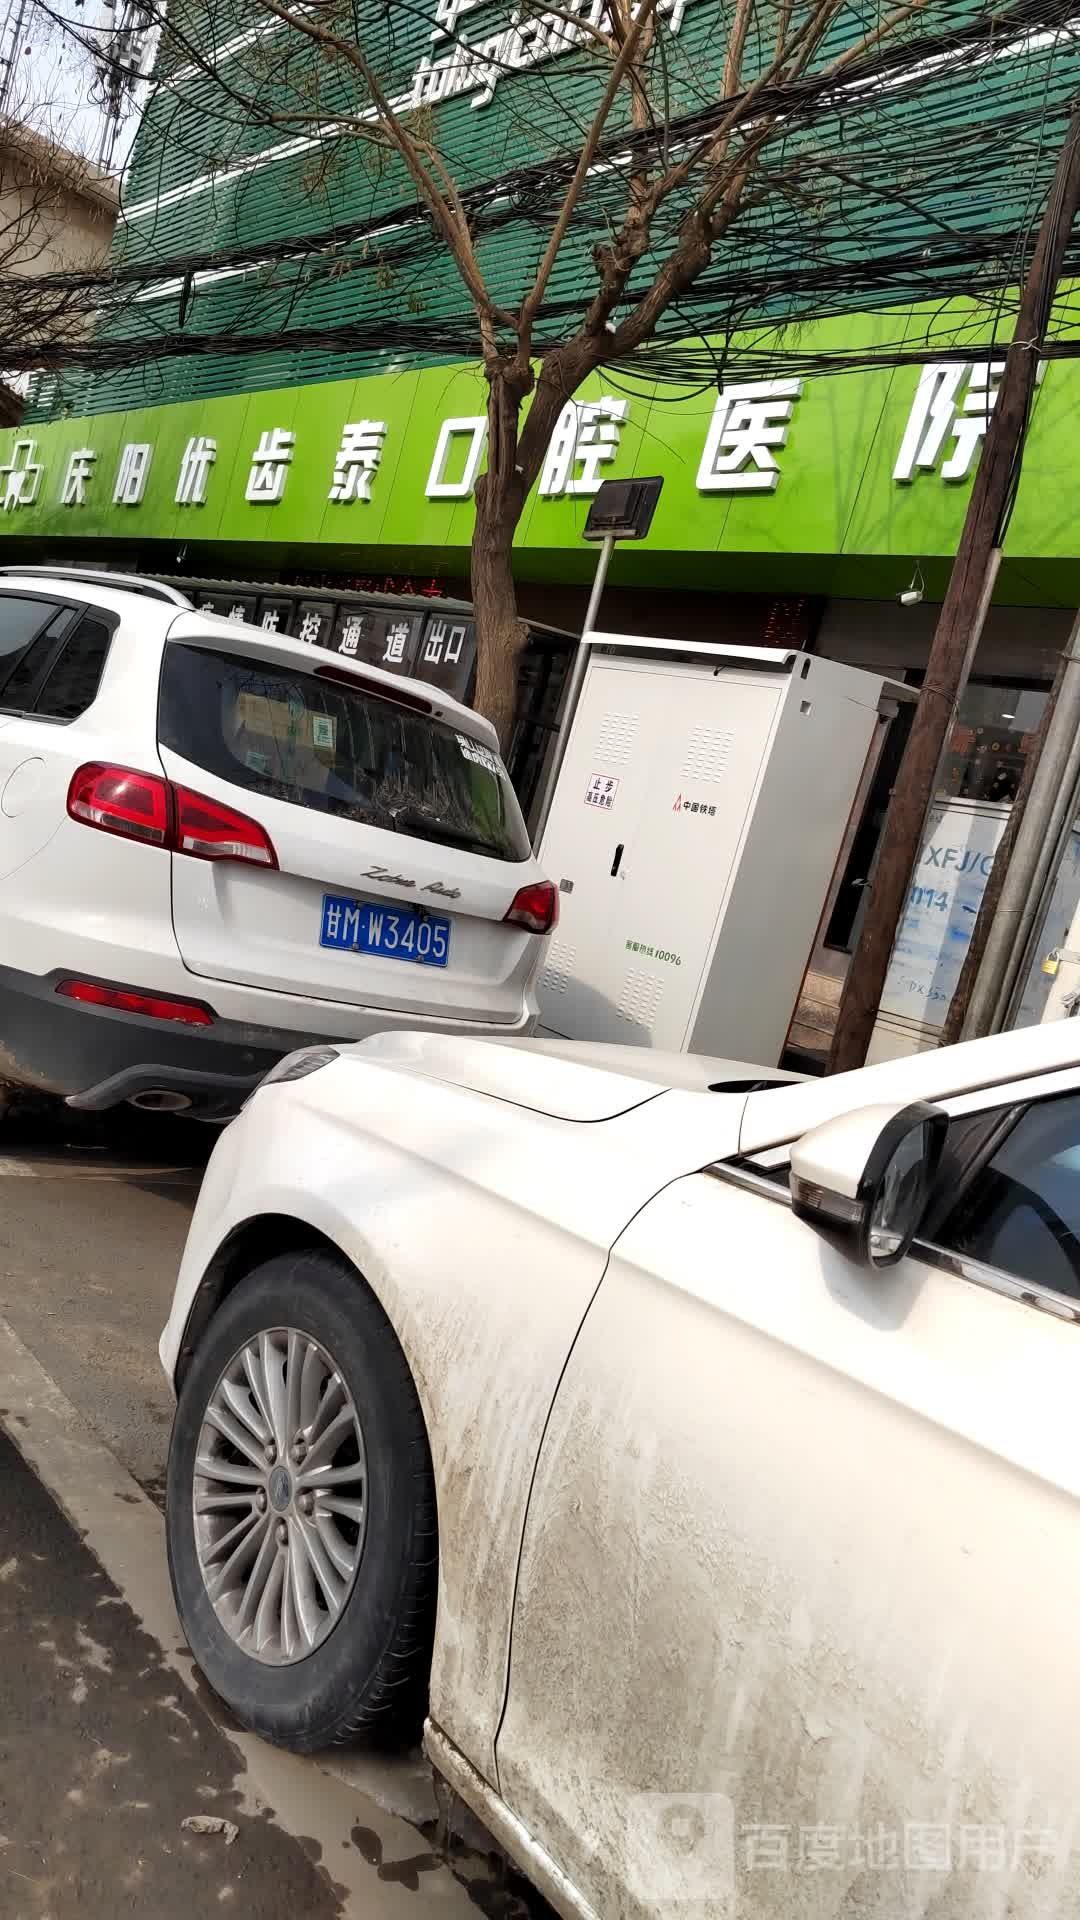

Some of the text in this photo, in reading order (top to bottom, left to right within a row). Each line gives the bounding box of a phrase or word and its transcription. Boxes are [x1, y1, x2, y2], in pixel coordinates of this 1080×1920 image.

[60, 361, 1046, 506] 庆阳优齿泰口腔医院
[201, 601, 466, 664] 情防控通道出口
[593, 778, 613, 792] 止步
[683, 801, 717, 816] 中国铁塔
[326, 903, 448, 957] 甘M·W3405
